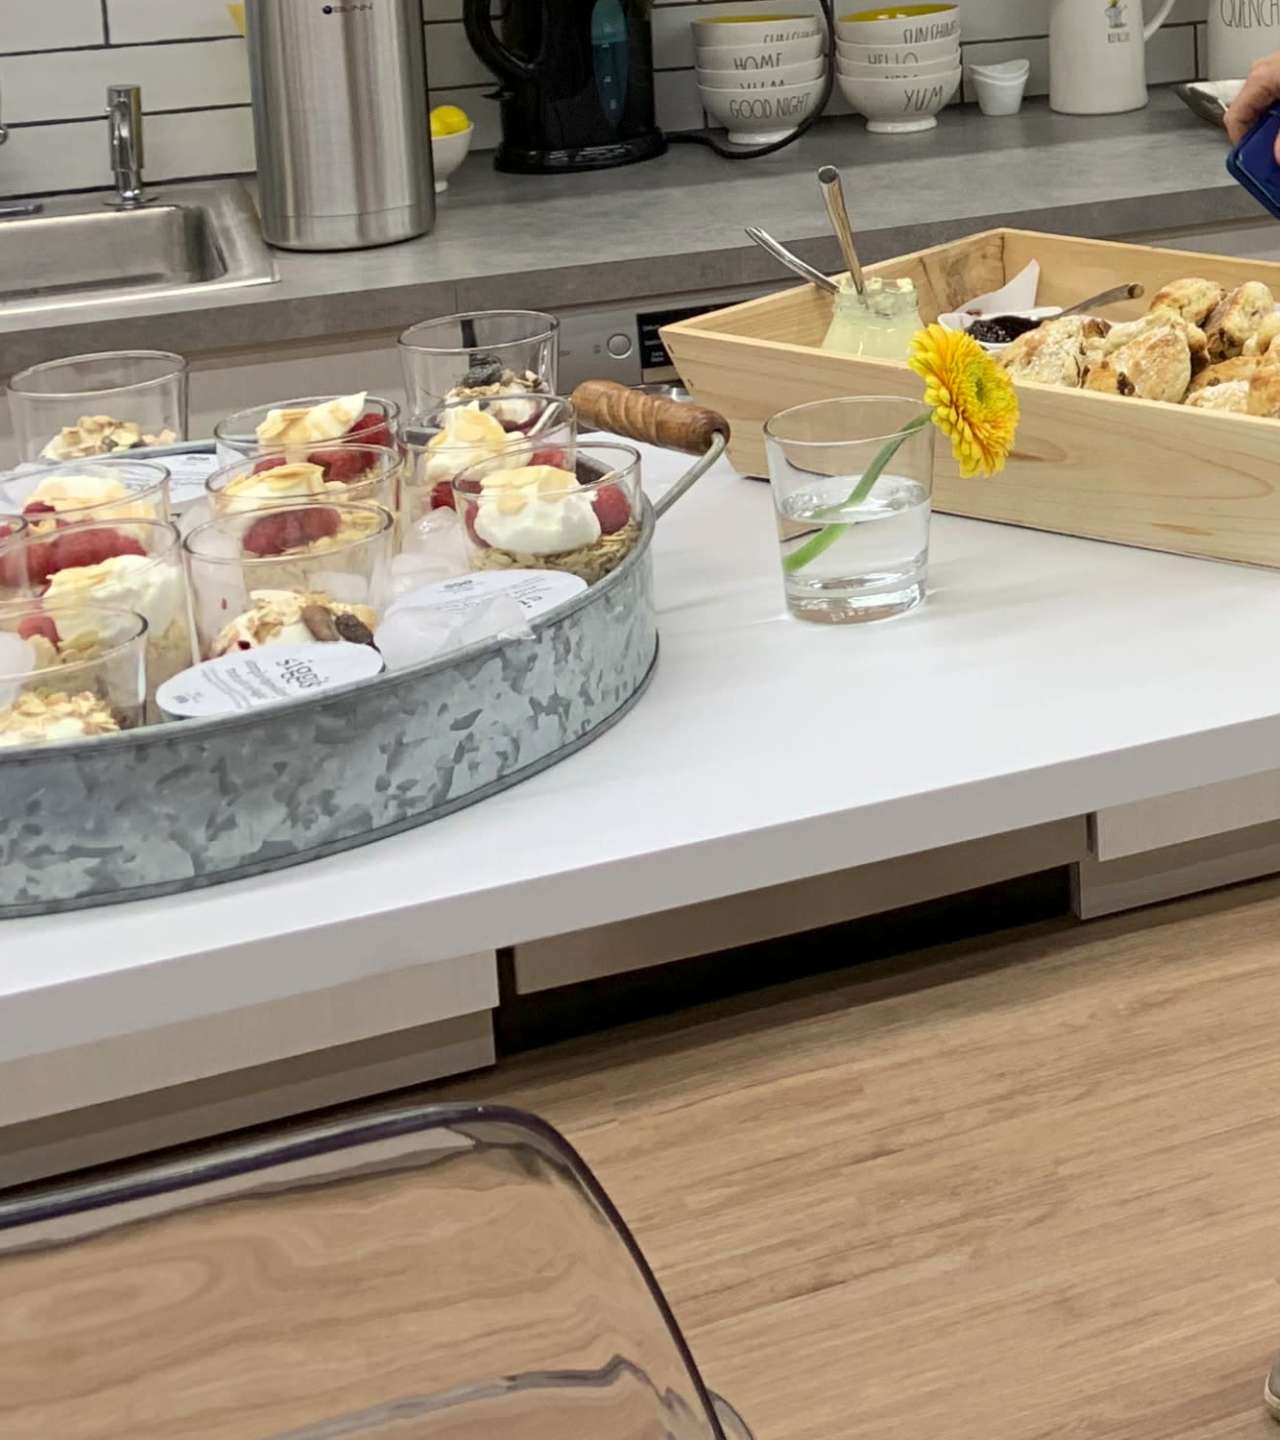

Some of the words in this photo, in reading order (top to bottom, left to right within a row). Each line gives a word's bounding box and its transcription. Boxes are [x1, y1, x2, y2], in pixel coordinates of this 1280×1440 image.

[729, 98, 772, 120] GOOD
[775, 92, 812, 118] NIGHT
[903, 85, 943, 112] YUM
